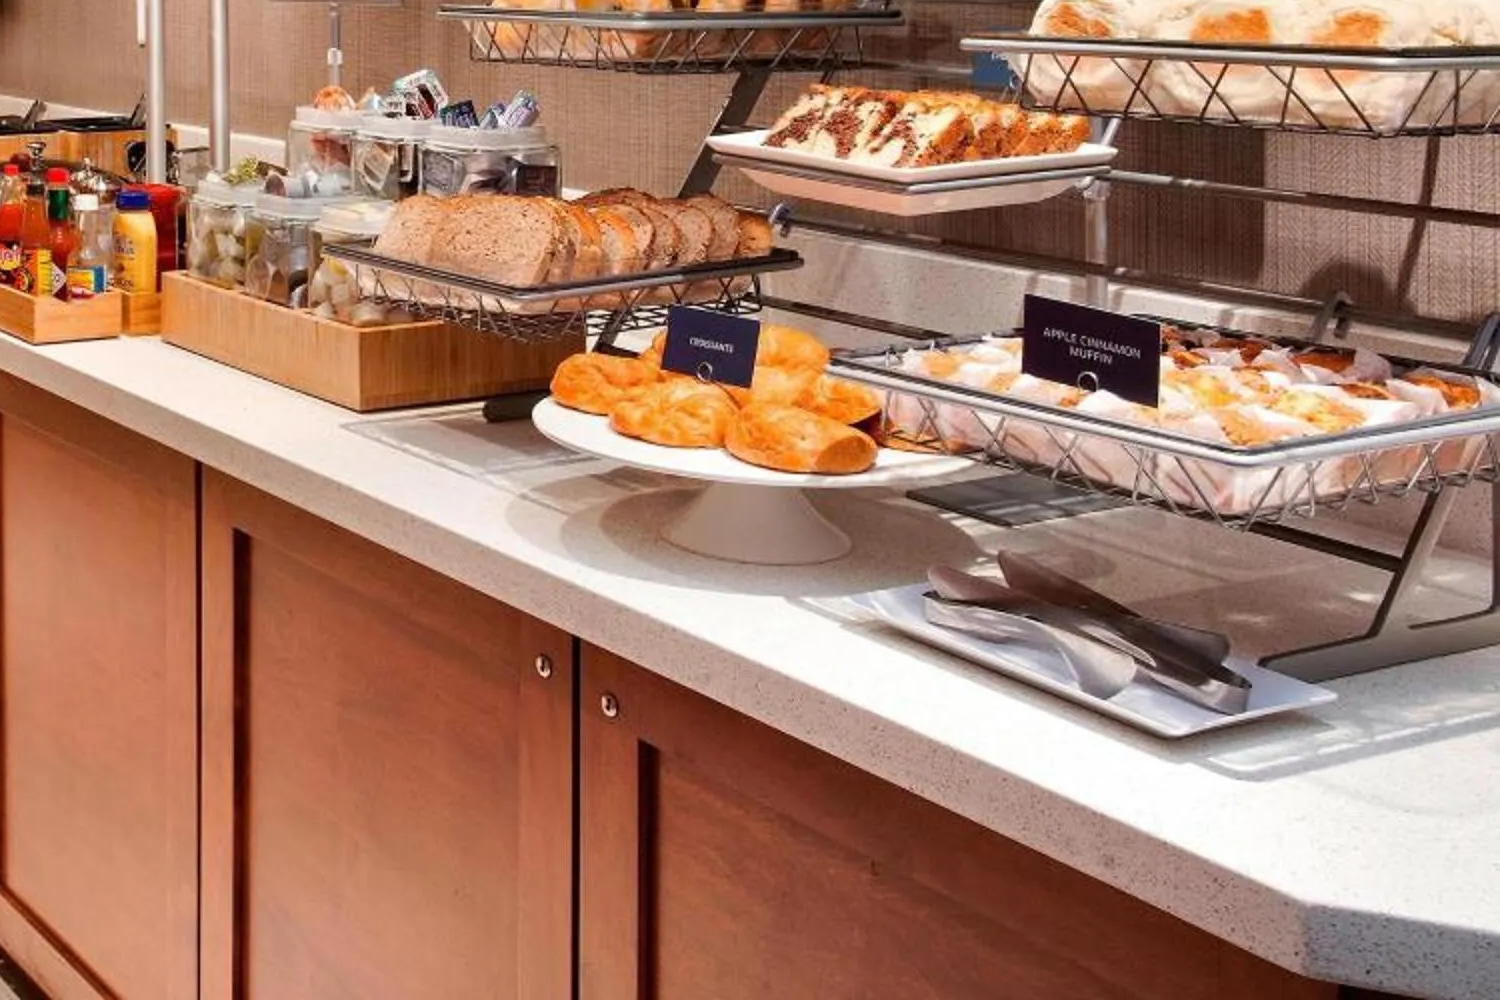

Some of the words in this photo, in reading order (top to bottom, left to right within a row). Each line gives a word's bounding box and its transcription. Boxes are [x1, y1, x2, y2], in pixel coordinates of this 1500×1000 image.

[1043, 327, 1077, 344] APPLE
[1080, 335, 1141, 359] CINNAMON
[1069, 345, 1113, 365] MUFFIN
